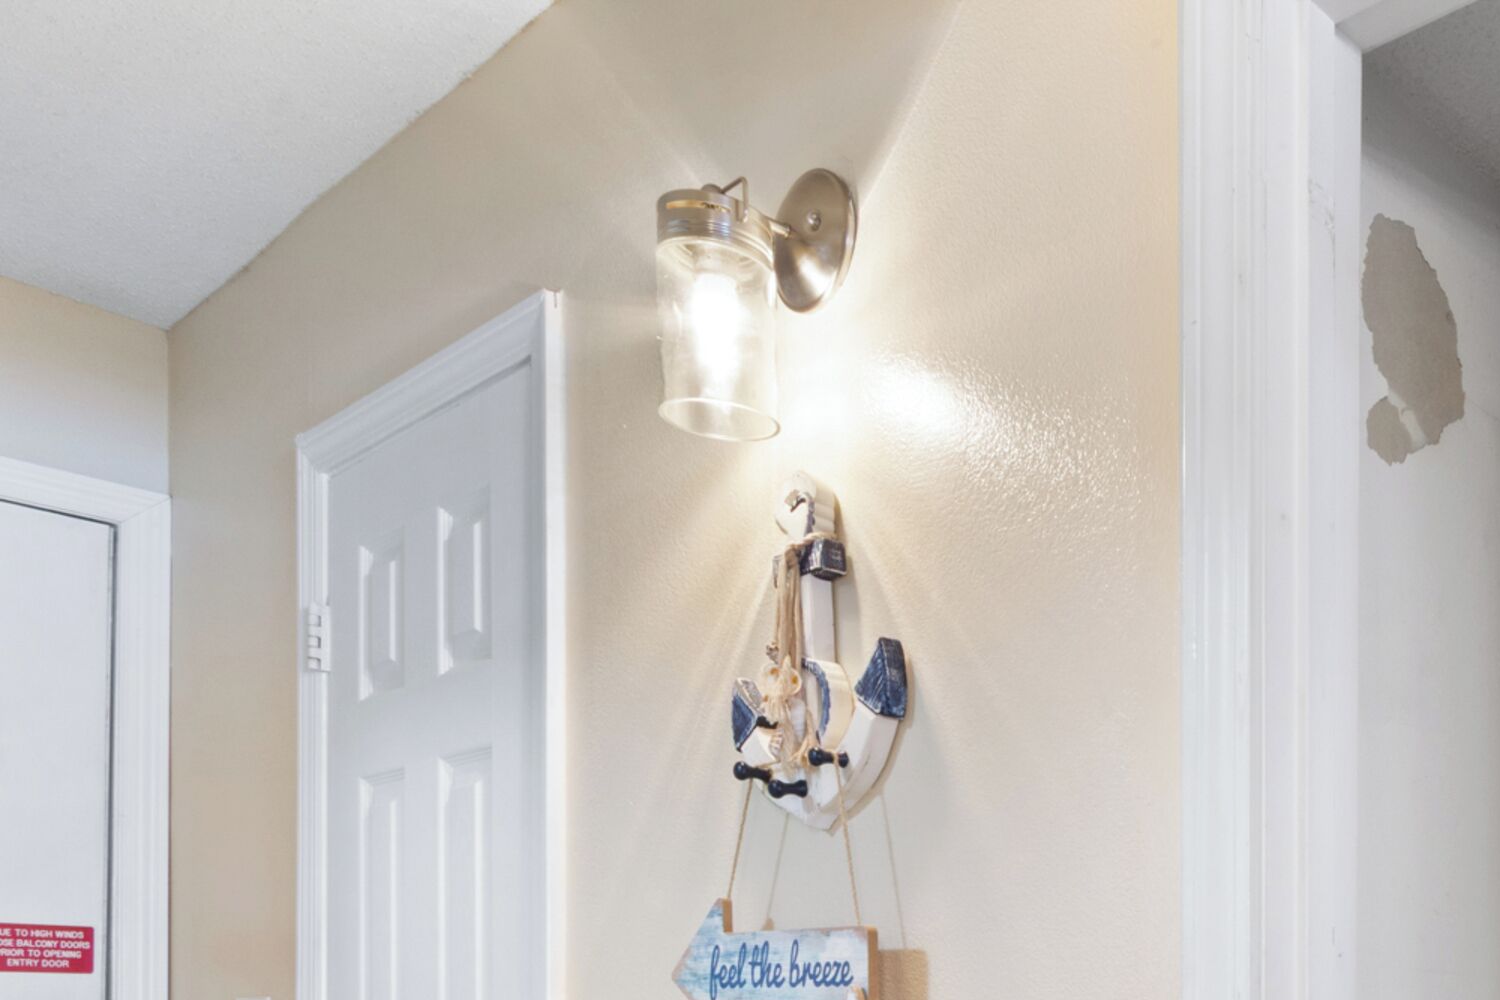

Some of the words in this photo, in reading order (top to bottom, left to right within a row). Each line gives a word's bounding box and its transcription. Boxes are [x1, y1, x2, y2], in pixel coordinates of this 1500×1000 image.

[15, 928, 28, 937] TO
[30, 929, 53, 938] HIGH
[55, 930, 84, 939] WINDS
[16, 938, 58, 948] BALCONY
[60, 940, 90, 950] DOORS
[28, 949, 41, 958] TO
[43, 949, 82, 959] OPENING
[6, 958, 39, 967] ENTRY
[41, 959, 70, 968] DOOR
[748, 938, 785, 988] the
[788, 938, 854, 988] breeze
